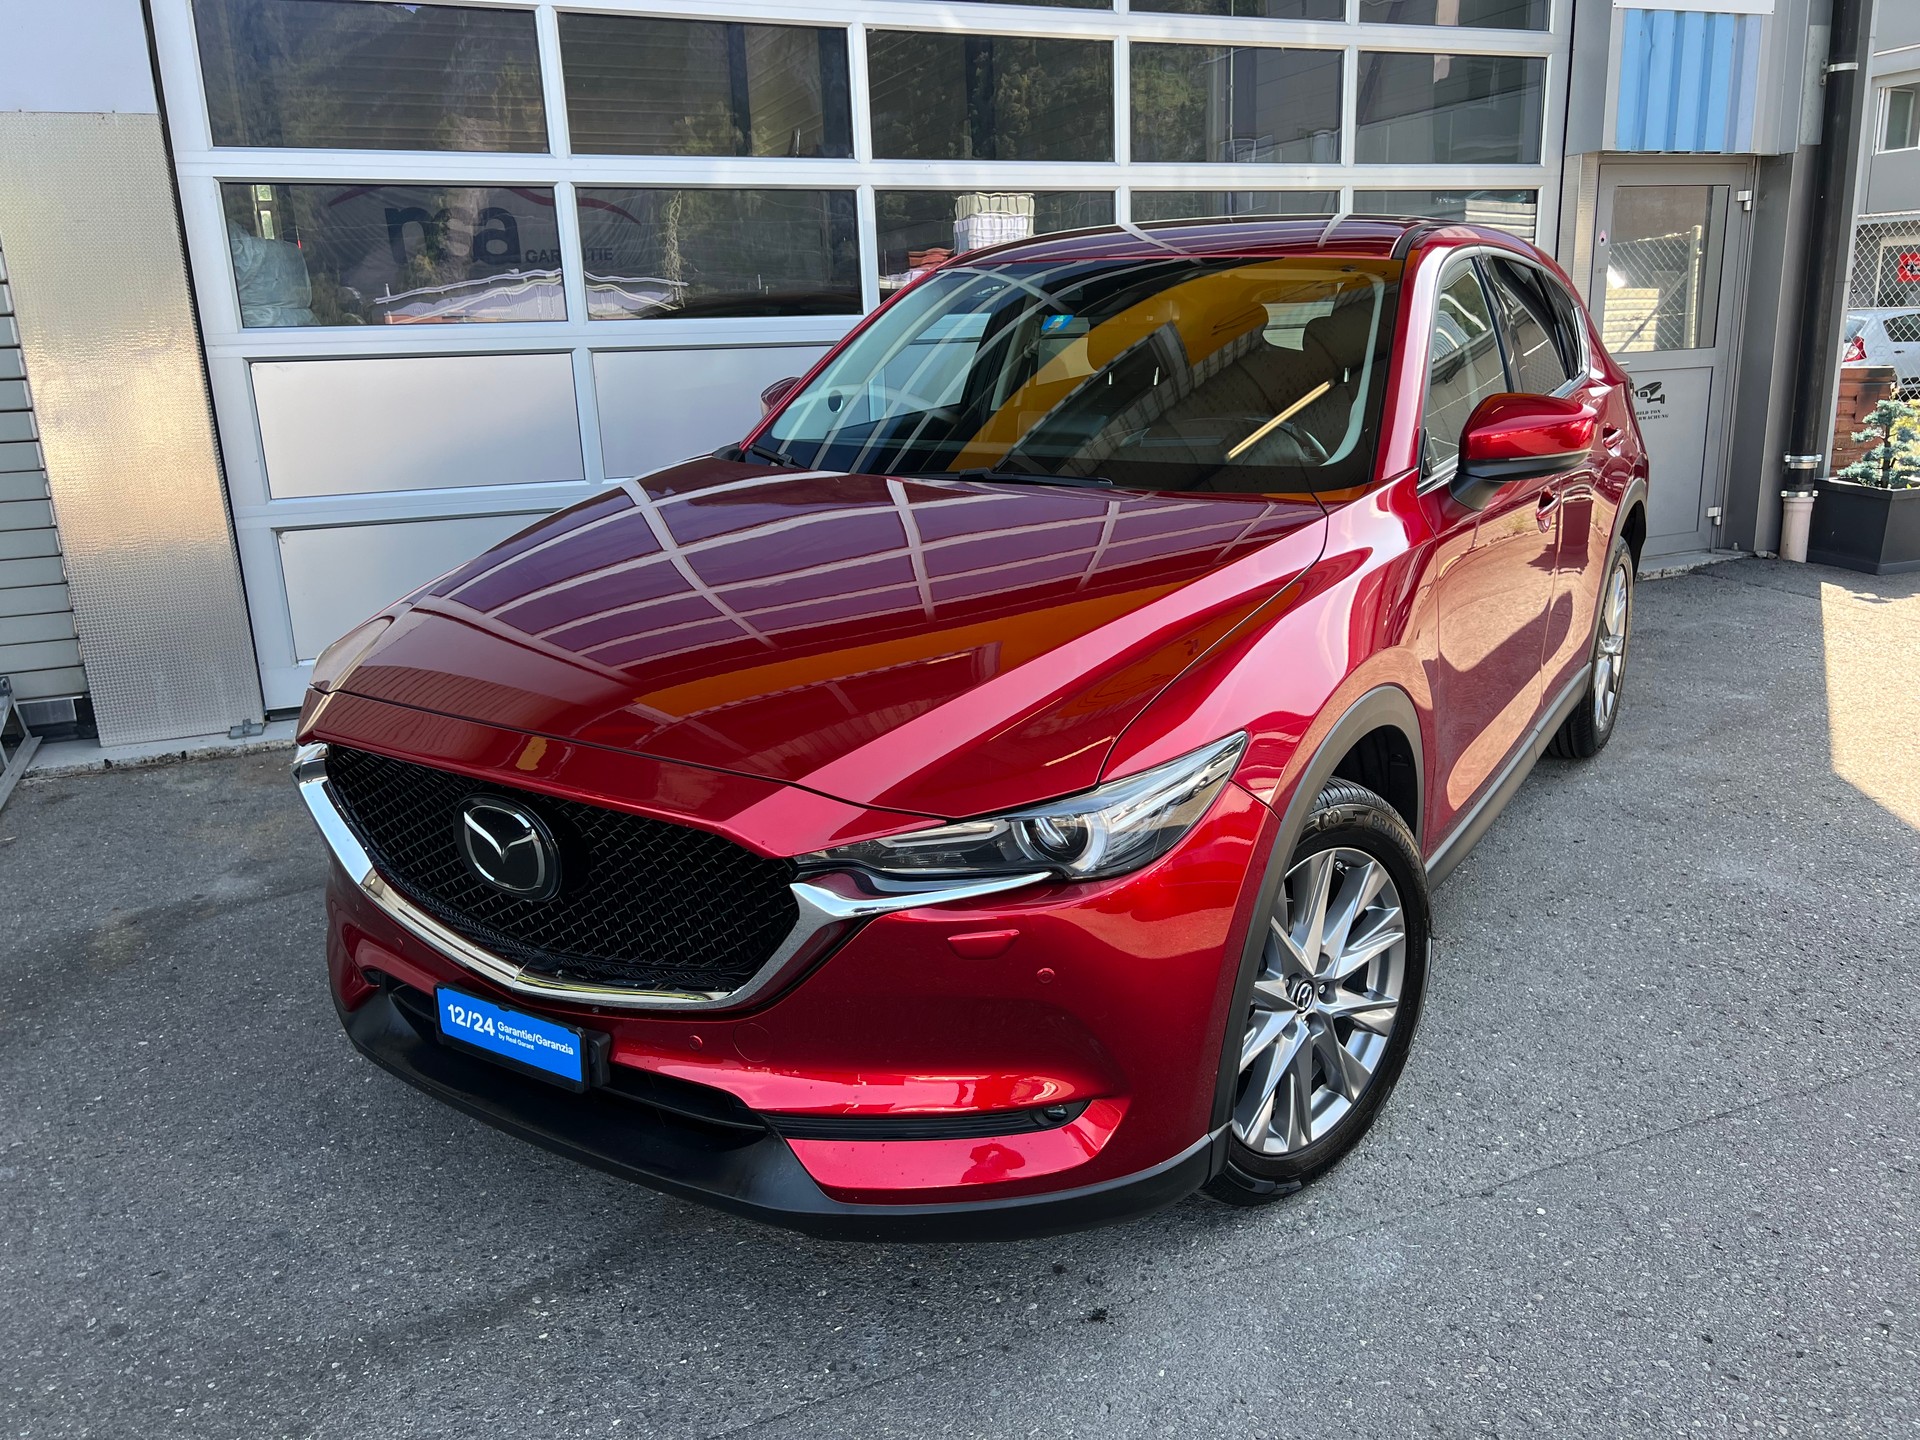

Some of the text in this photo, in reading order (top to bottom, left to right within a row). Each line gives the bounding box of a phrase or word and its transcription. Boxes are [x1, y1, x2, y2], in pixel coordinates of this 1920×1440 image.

[525, 248, 613, 263] GARTIE
[447, 1003, 574, 1056] 12/24 Garantie/Garanzia
[498, 1033, 535, 1050] by Real Garant
